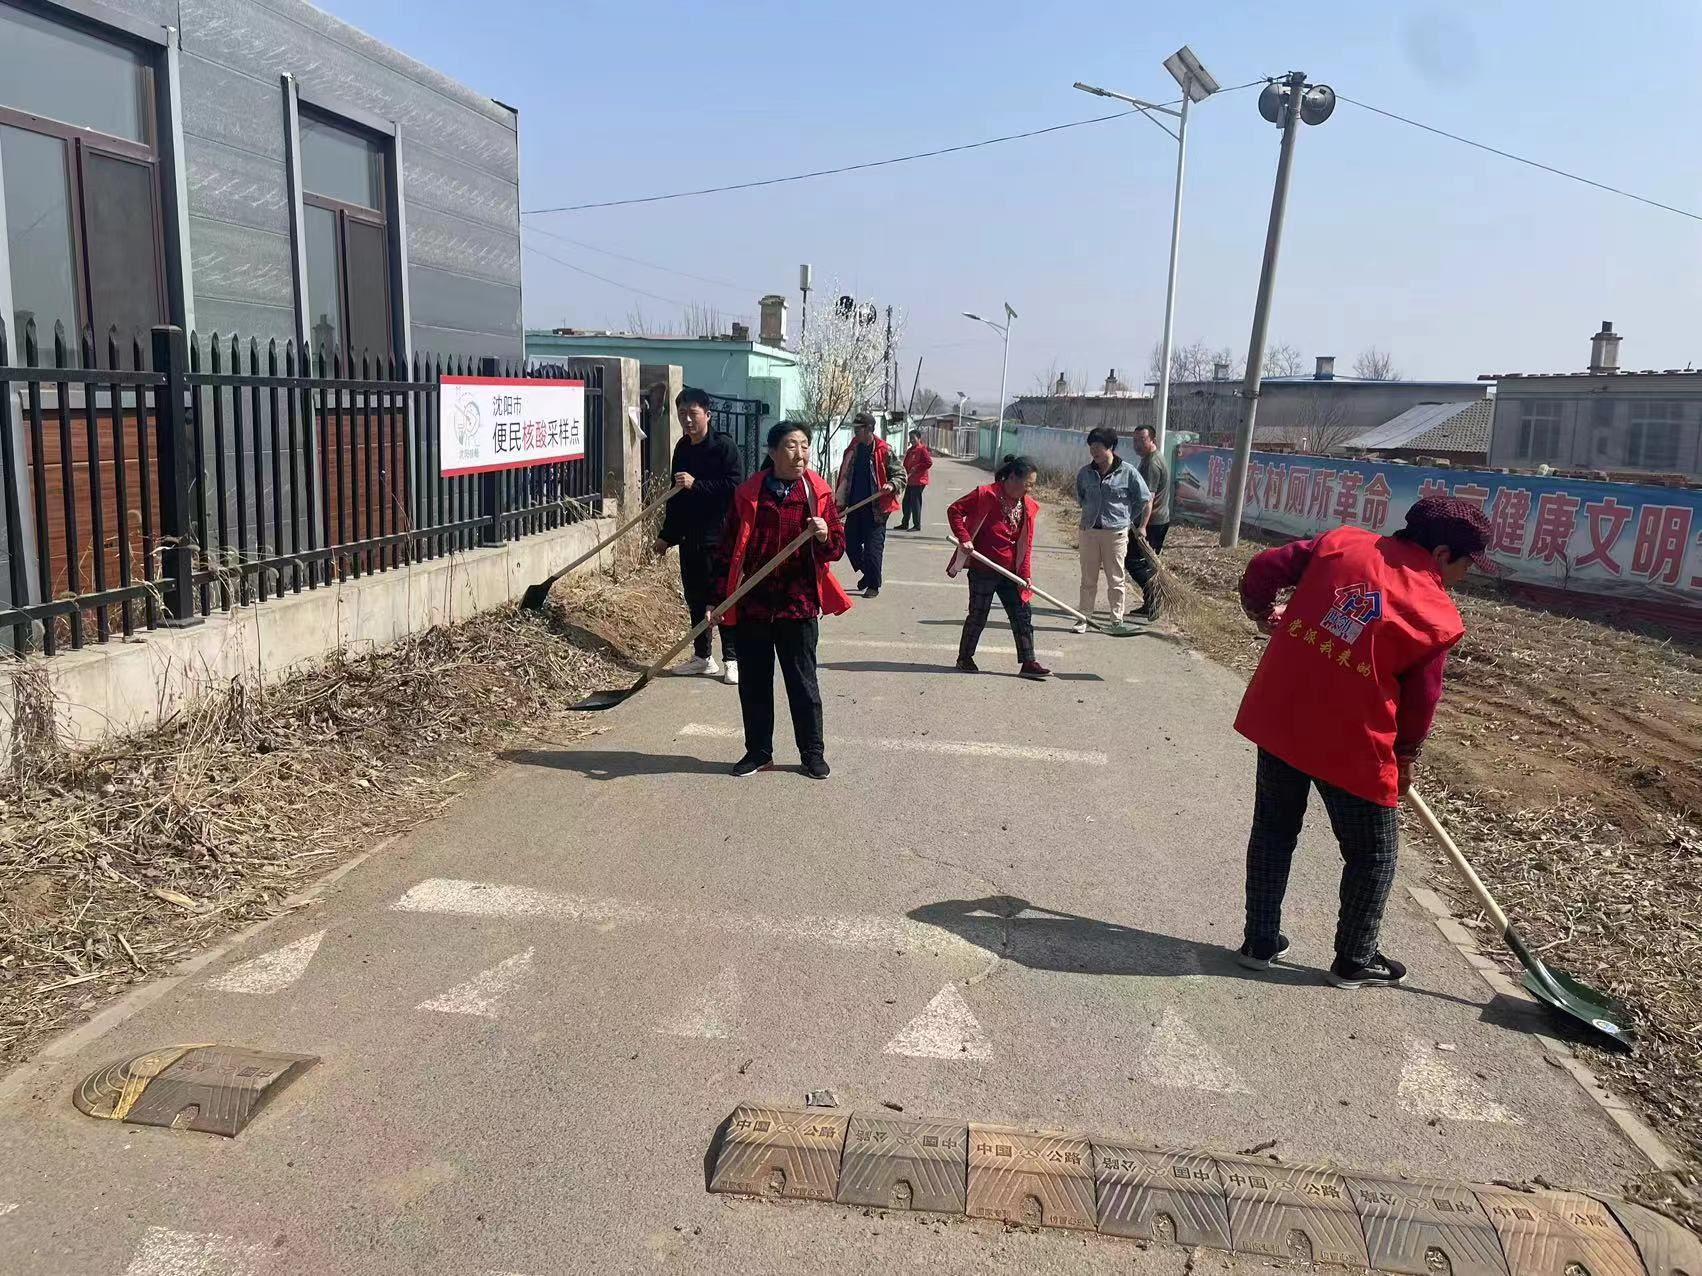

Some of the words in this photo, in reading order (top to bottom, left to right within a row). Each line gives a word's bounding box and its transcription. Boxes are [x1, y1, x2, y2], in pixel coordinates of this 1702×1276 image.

[492, 395, 522, 416] 沈阳市
[492, 418, 580, 454] 便民核酸采样点
[1207, 455, 1392, 529] 推农村厕所革命
[735, 1118, 771, 1133] 中国
[976, 1142, 1013, 1158] 中国
[1228, 1172, 1268, 1190] 中国
